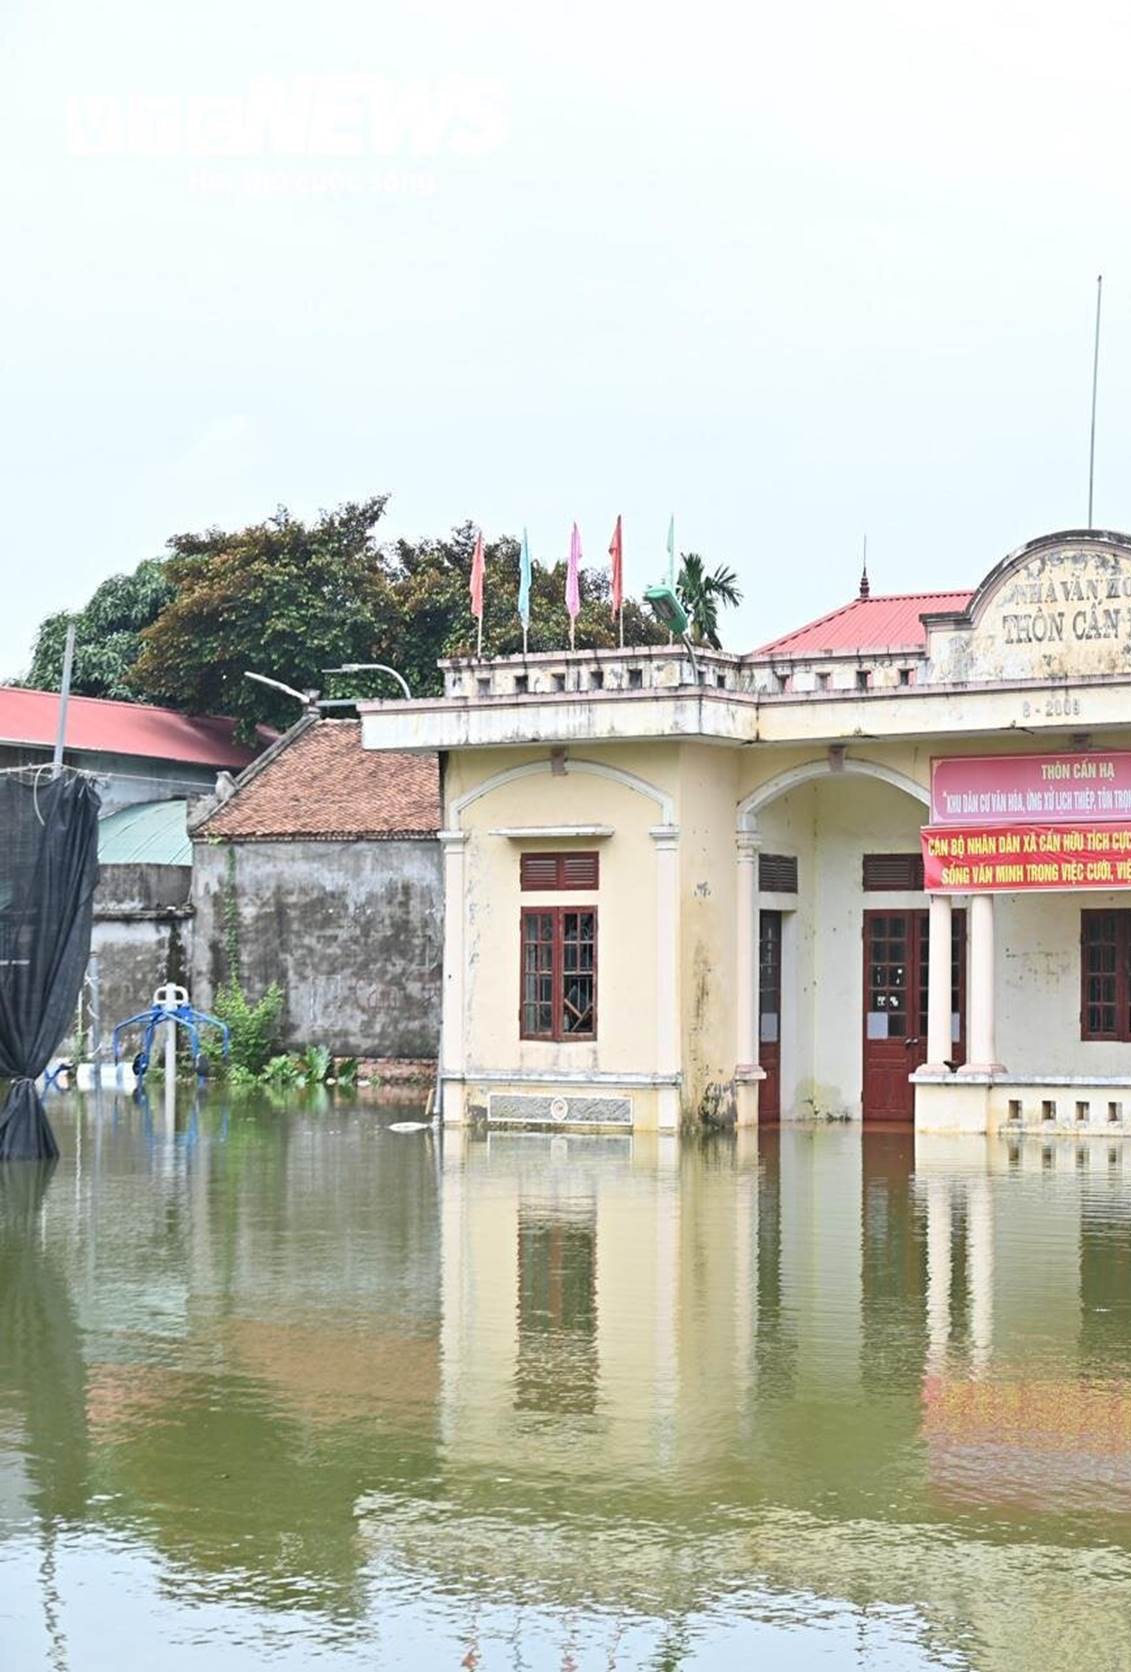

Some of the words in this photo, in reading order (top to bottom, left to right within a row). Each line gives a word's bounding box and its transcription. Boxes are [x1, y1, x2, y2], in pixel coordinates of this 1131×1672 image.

[1015, 575, 1058, 605] NHÀ
[1060, 571, 1100, 602] VĂN
[1002, 606, 1065, 644] THÔN
[1072, 600, 1121, 641] CẤN
[1041, 760, 1071, 780] THÔN
[1073, 758, 1097, 779] CẤN
[1099, 761, 1115, 781] HẠ
[962, 789, 978, 813] DÂN
[991, 789, 1008, 812] VĂN
[1055, 790, 1073, 814] LỊCH
[1097, 786, 1113, 811] TÔN
[927, 835, 948, 856] CÁN
[951, 837, 964, 859] BỘ
[967, 833, 996, 856] NHÂN
[998, 833, 1021, 854] DÂN
[1023, 832, 1038, 853] XÃ
[1039, 827, 1061, 853] CẤN
[1086, 828, 1110, 850] TÍCH
[941, 860, 970, 885] SỐNG
[972, 861, 993, 884] VĂN
[995, 863, 1024, 883] MINH
[1026, 863, 1059, 882] TRONG
[1061, 859, 1084, 885] VIỆC
